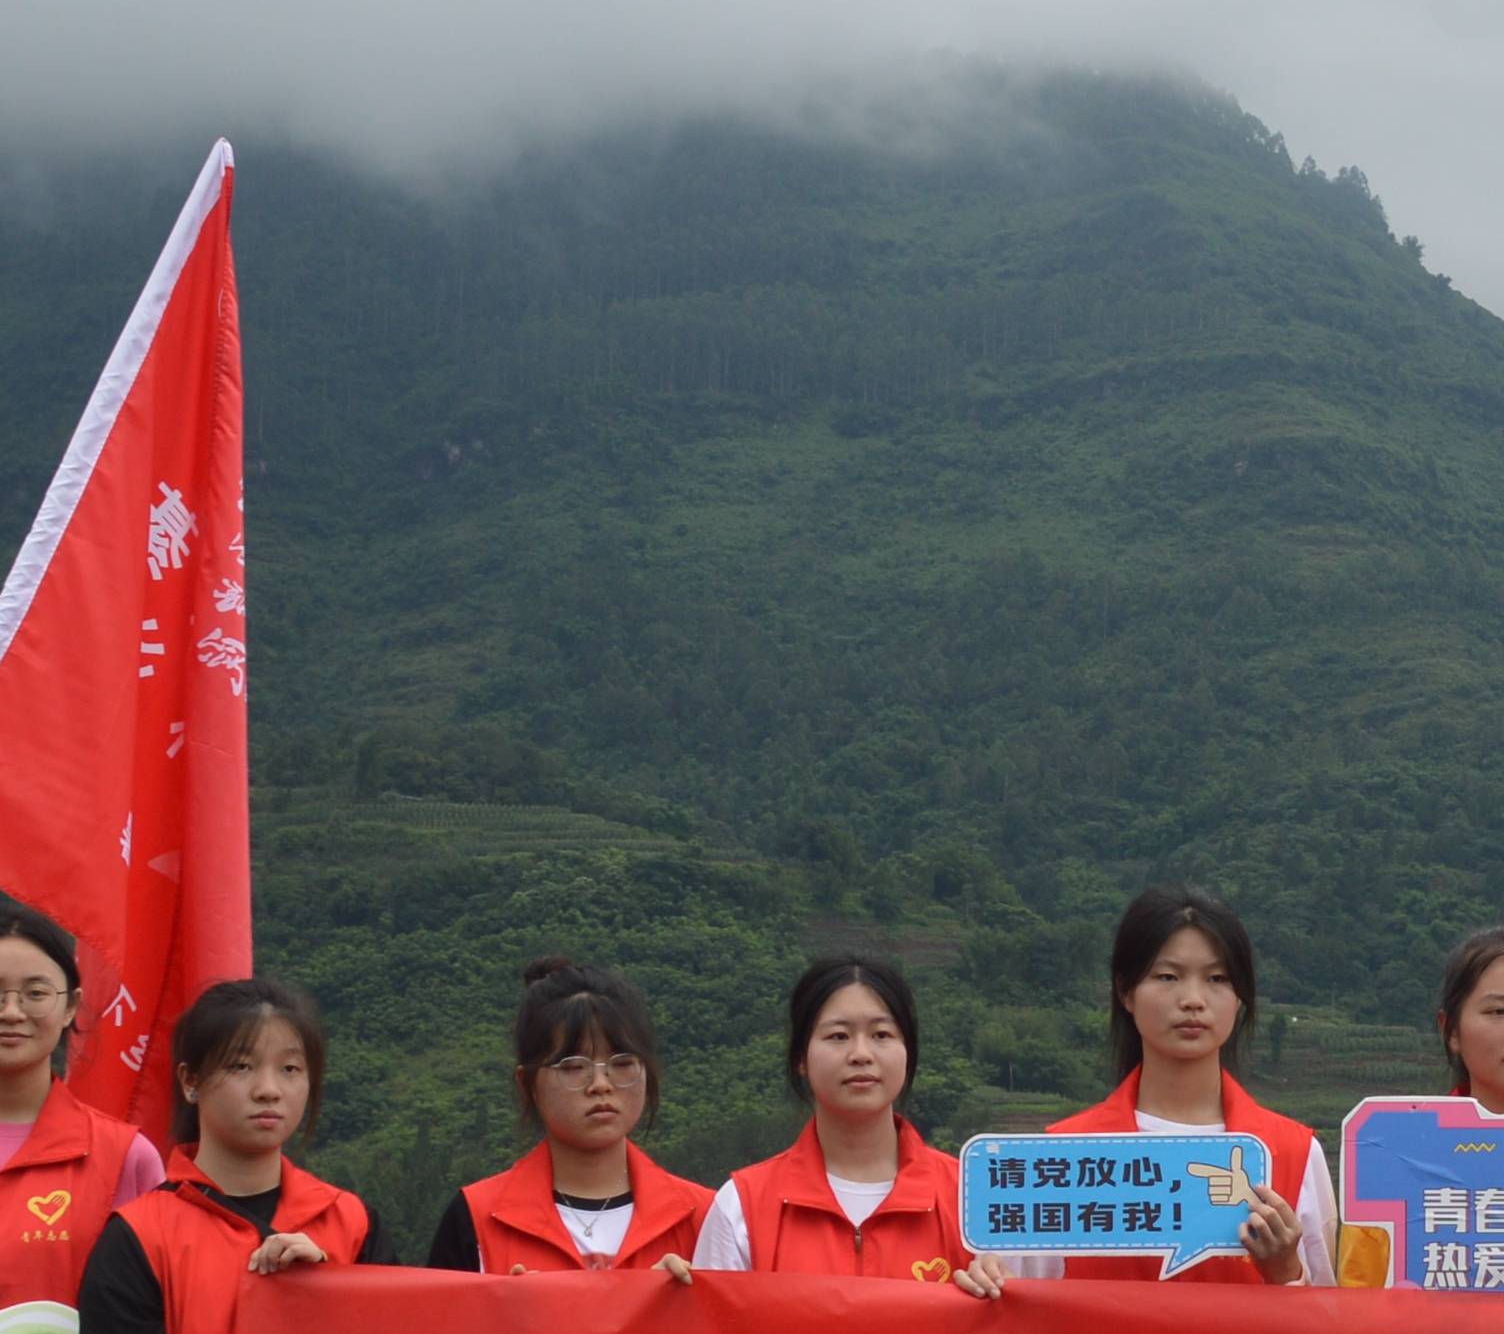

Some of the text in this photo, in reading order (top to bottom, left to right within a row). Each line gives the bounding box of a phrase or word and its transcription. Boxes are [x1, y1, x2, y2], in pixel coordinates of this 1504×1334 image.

[987, 1157, 1181, 1193] 请党放心，
[987, 1202, 1183, 1234] 强国有我！
